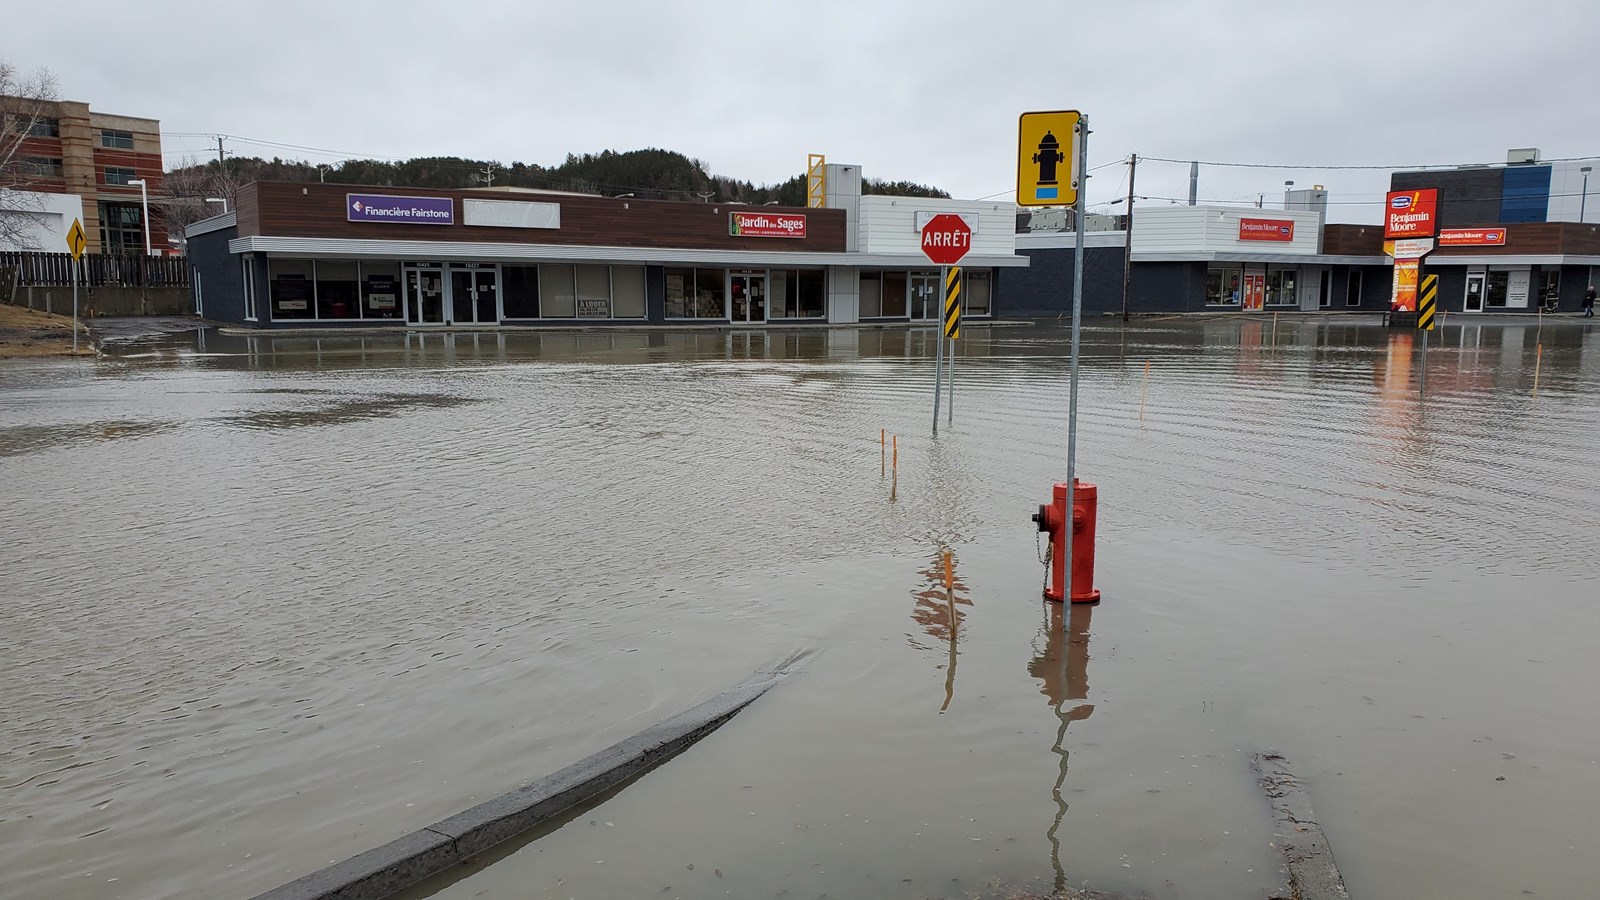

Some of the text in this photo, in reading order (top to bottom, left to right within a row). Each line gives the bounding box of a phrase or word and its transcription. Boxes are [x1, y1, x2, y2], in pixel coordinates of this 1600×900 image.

[365, 206, 449, 218] Financière Fairstone
[1390, 212, 1429, 223] Benjamin
[739, 216, 768, 228] Jardin
[777, 218, 803, 232] Sages
[1241, 223, 1263, 231] Benjamin
[1390, 222, 1416, 232] Moore
[923, 229, 969, 247] ARRÊT
